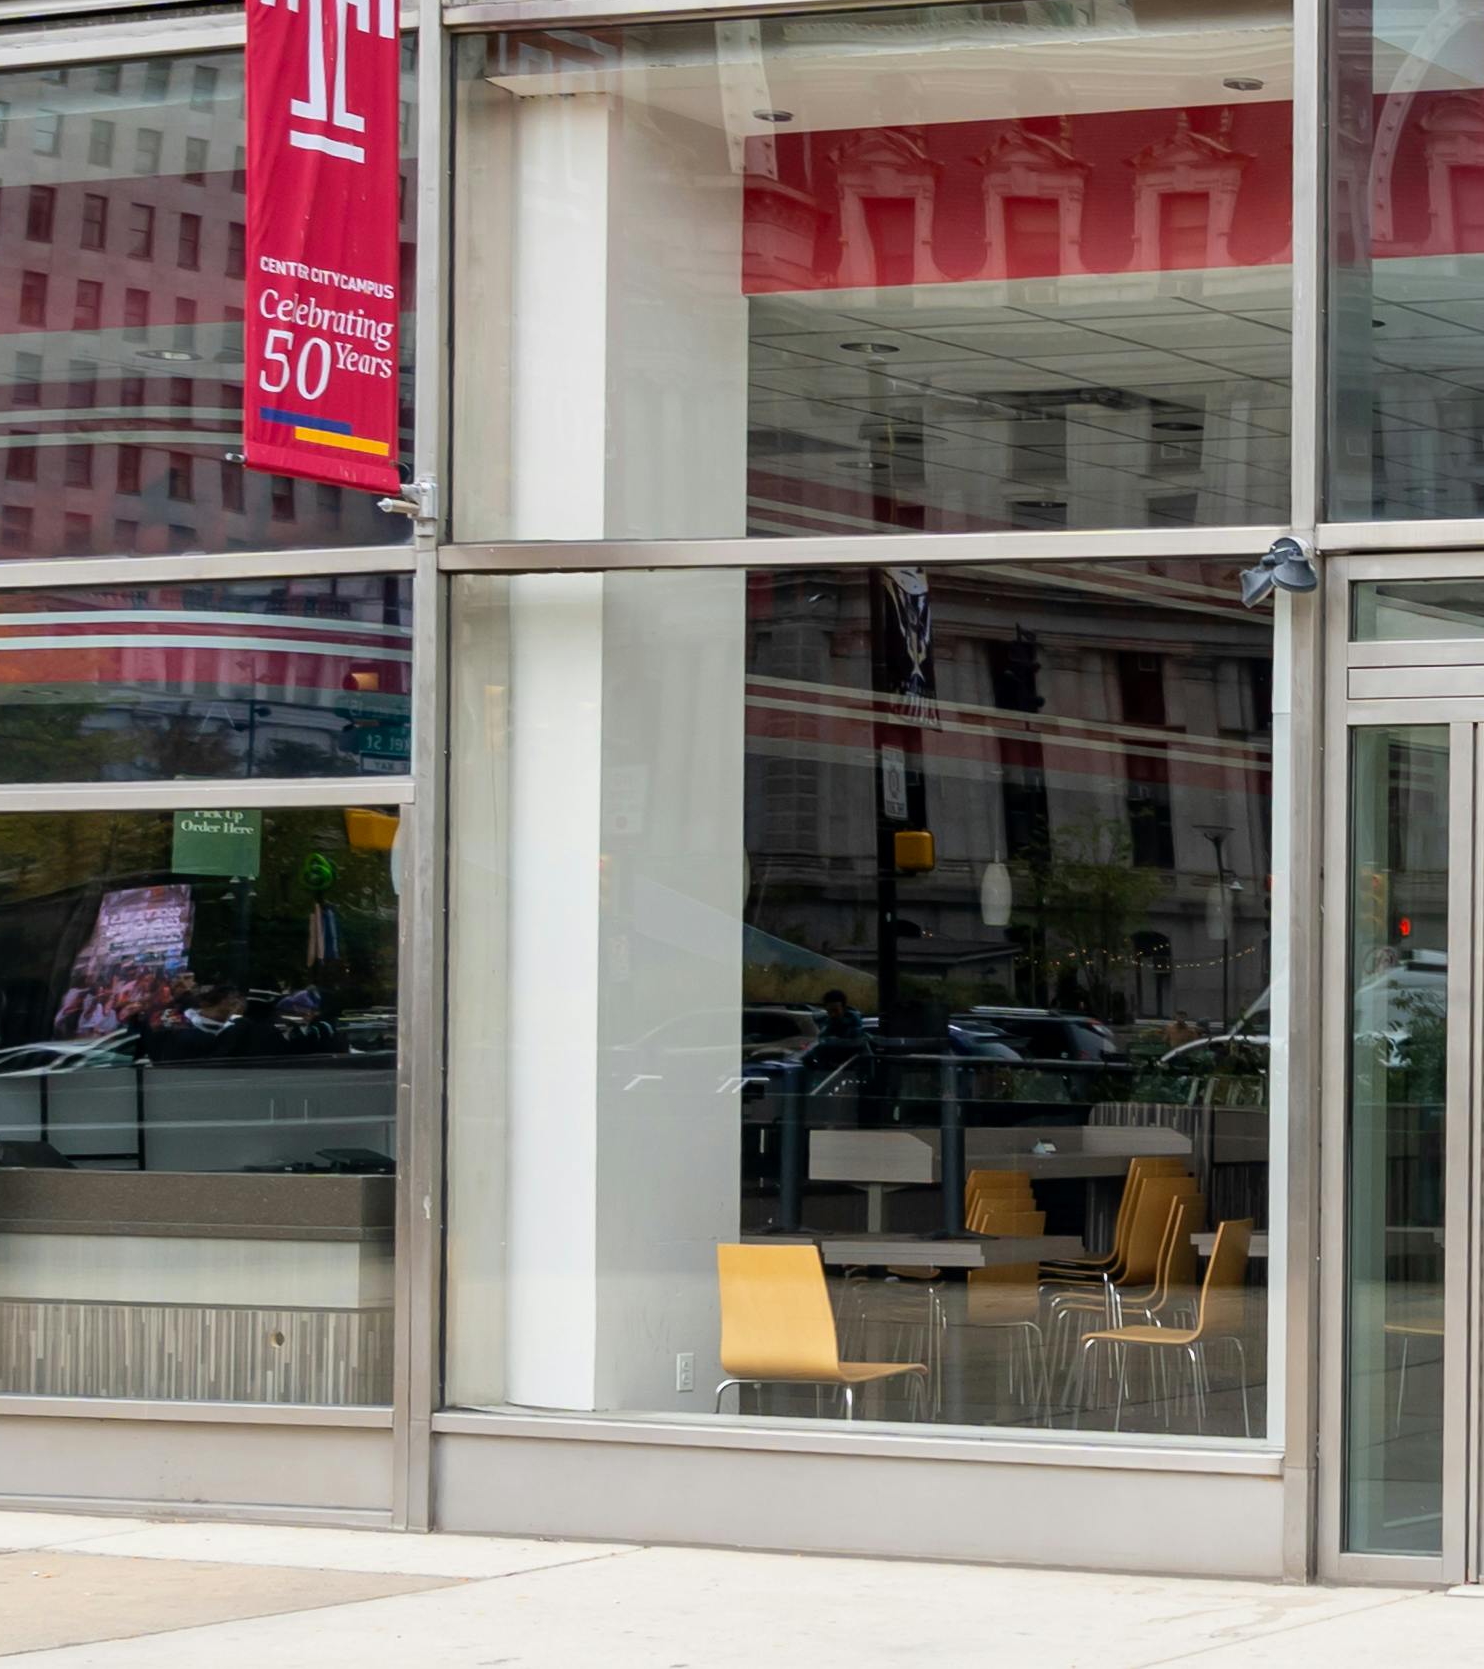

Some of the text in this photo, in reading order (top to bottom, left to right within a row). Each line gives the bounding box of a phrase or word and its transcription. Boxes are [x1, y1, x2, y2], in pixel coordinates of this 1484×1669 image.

[310, 267, 341, 287] CITY
[340, 276, 395, 300] CAMPUS
[259, 289, 395, 352] Celebrating
[259, 328, 393, 401] 50 Years
[180, 819, 255, 835] Order Here
